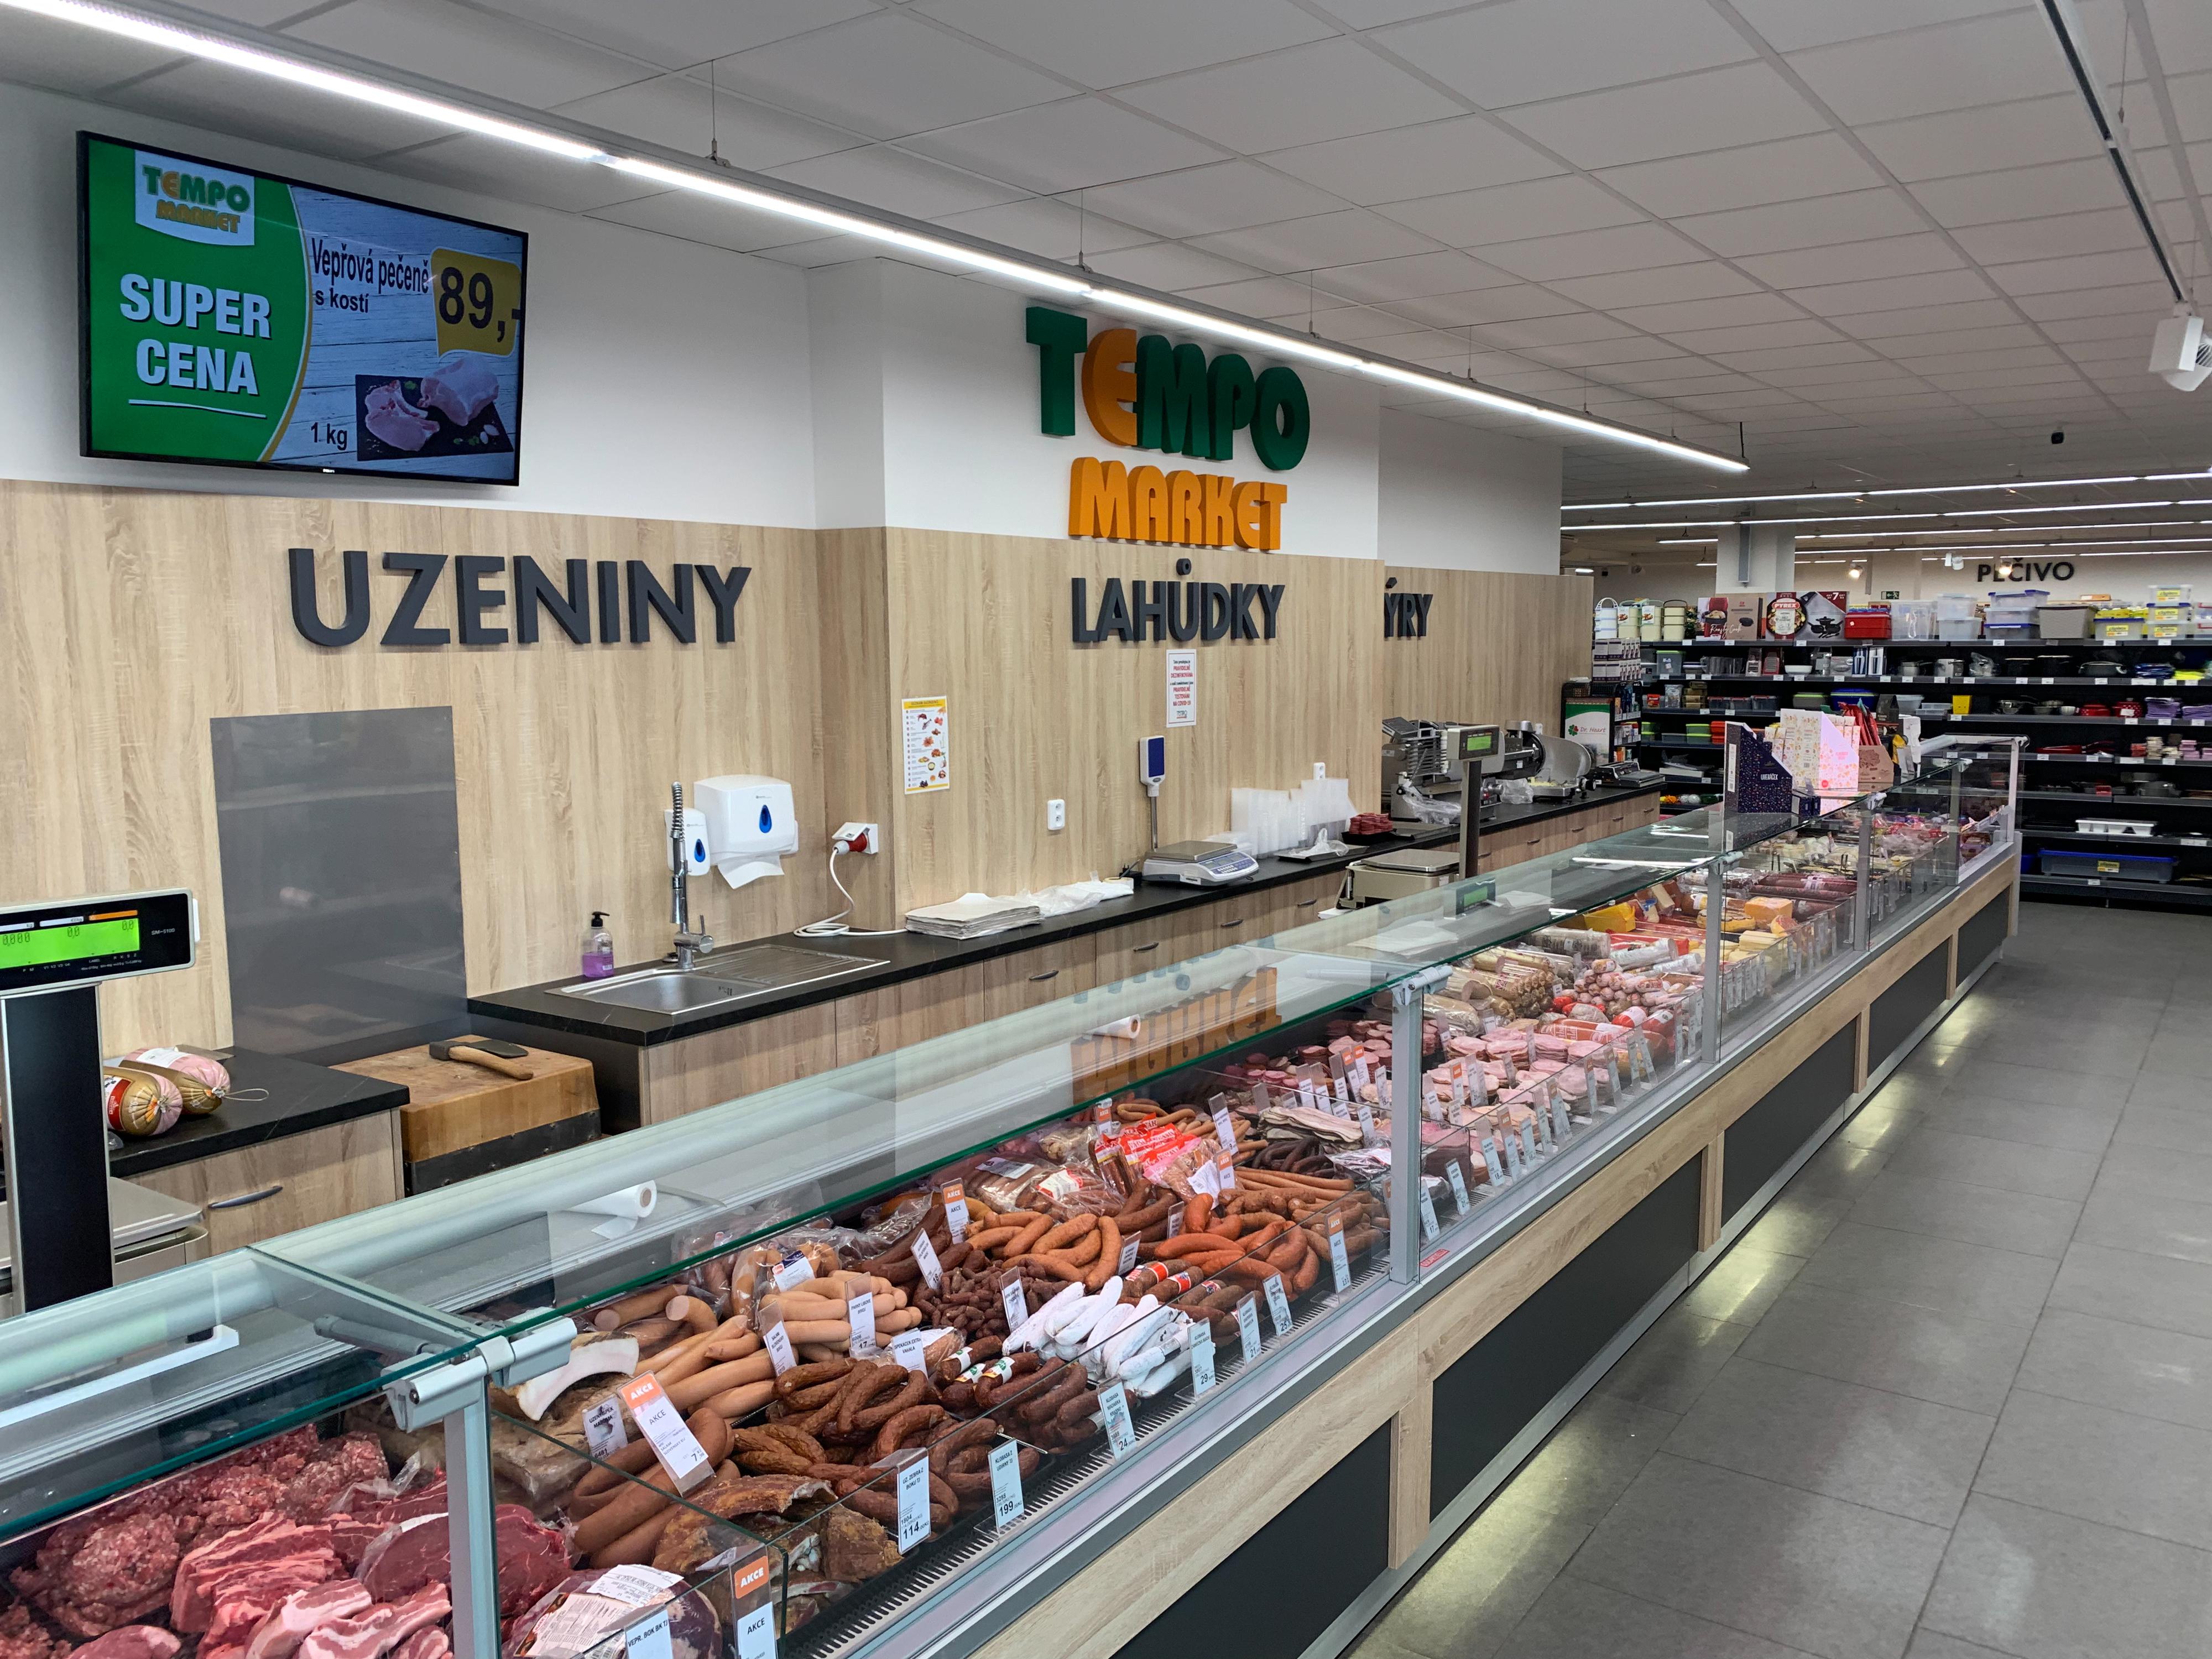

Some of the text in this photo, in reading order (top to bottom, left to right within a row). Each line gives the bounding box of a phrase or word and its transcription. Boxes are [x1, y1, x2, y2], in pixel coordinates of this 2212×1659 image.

[142, 165, 251, 213] TEMPO
[155, 199, 240, 233] MARKET
[312, 238, 429, 294] Vepřová pečeně
[119, 273, 271, 339] SUPER
[315, 288, 369, 313] s kostí
[136, 339, 259, 396] CENA
[1025, 306, 1310, 471] TEMPO
[311, 422, 347, 450] 1 kg
[1068, 457, 1287, 551] MARKET
[289, 548, 752, 647] UZENINY
[1072, 558, 1285, 643] LAHŮDKY
[1384, 577, 1433, 637] ÝRY
[947, 1190, 961, 1199] AKCE
[1201, 1373, 1208, 1385] 29
[630, 1383, 654, 1400] AKCE
[649, 1409, 666, 1425] AKCE
[1119, 1438, 1128, 1451] 24
[691, 1453, 697, 1462] 7
[995, 1452, 1010, 1464] KLOBASA
[906, 1480, 916, 1490] BOKU
[909, 1469, 921, 1480] ZEBRA
[740, 1567, 764, 1588] AKCE
[628, 1635, 643, 1647] VEPR.
[644, 1627, 655, 1640] BOK
[655, 1624, 663, 1632] BK
[747, 1617, 765, 1635] AKCE
